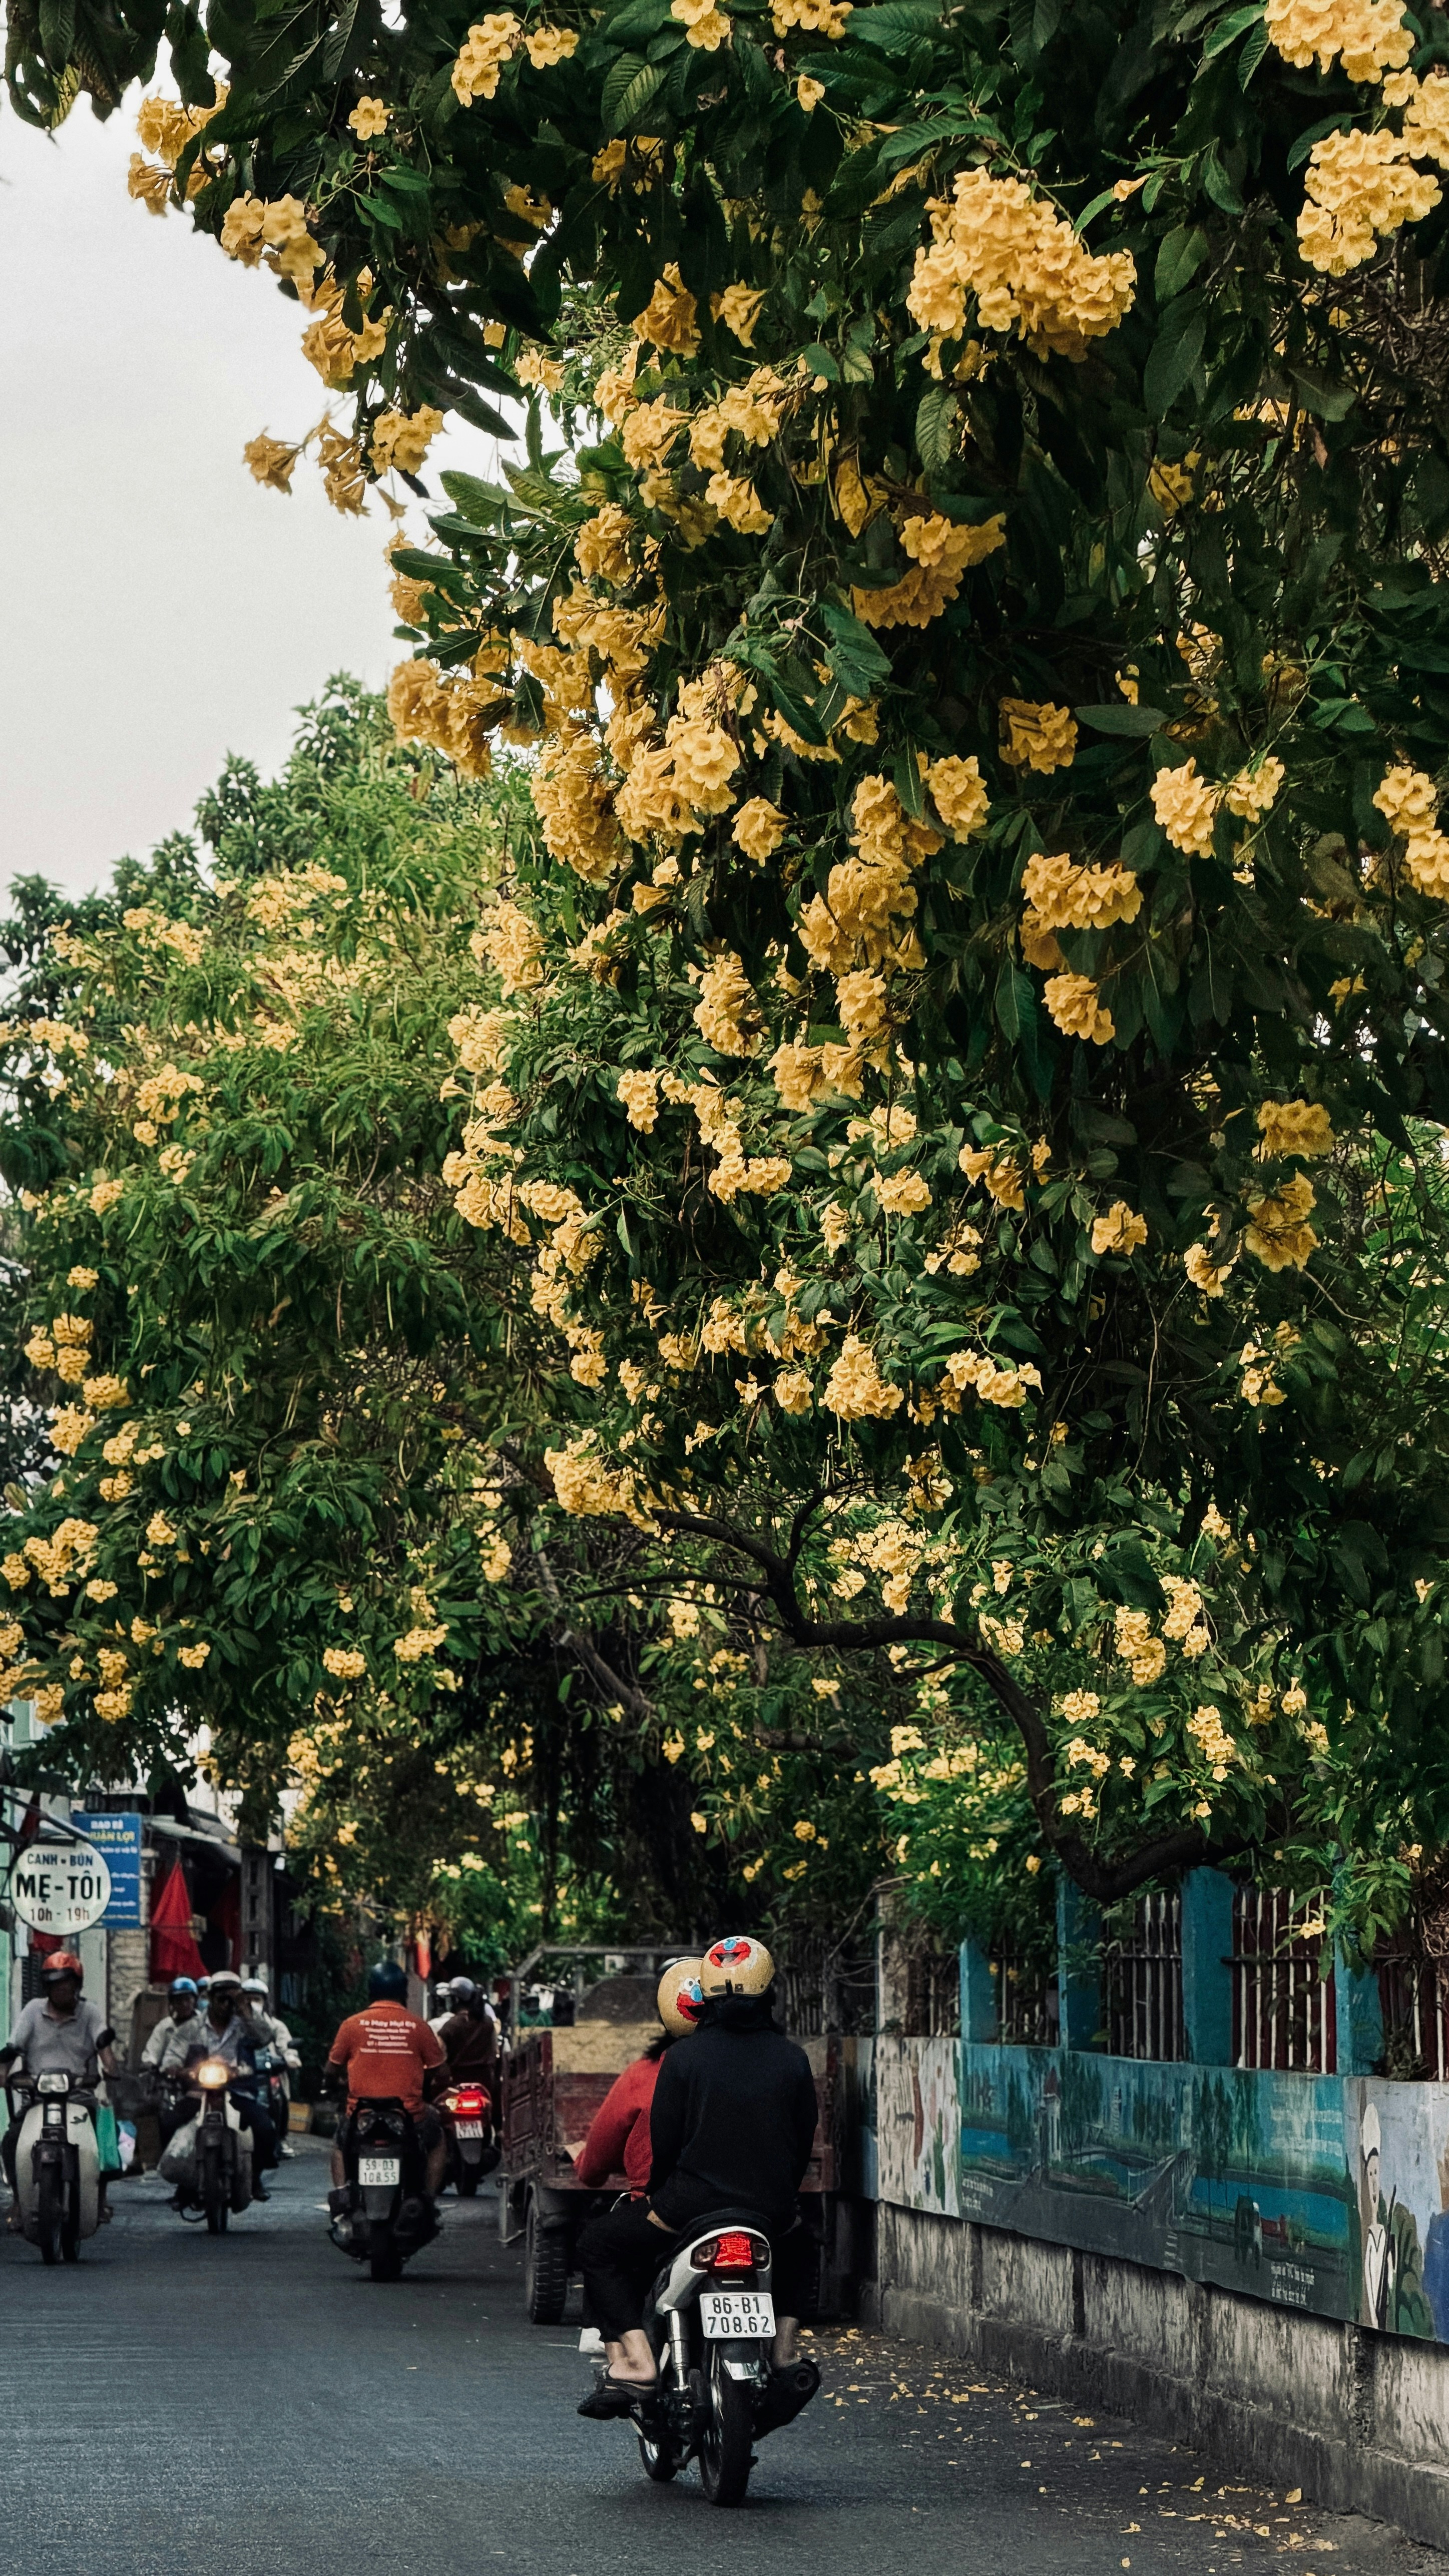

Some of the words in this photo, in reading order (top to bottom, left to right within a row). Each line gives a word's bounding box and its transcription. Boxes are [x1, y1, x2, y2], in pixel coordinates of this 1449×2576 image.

[28, 1854, 58, 1866] CANH
[70, 1853, 93, 1866] BÚN
[31, 1907, 52, 1921] 10h
[68, 1907, 90, 1921] 19h
[712, 2297, 760, 2314] 86-B1
[707, 2316, 770, 2334] 708.62
